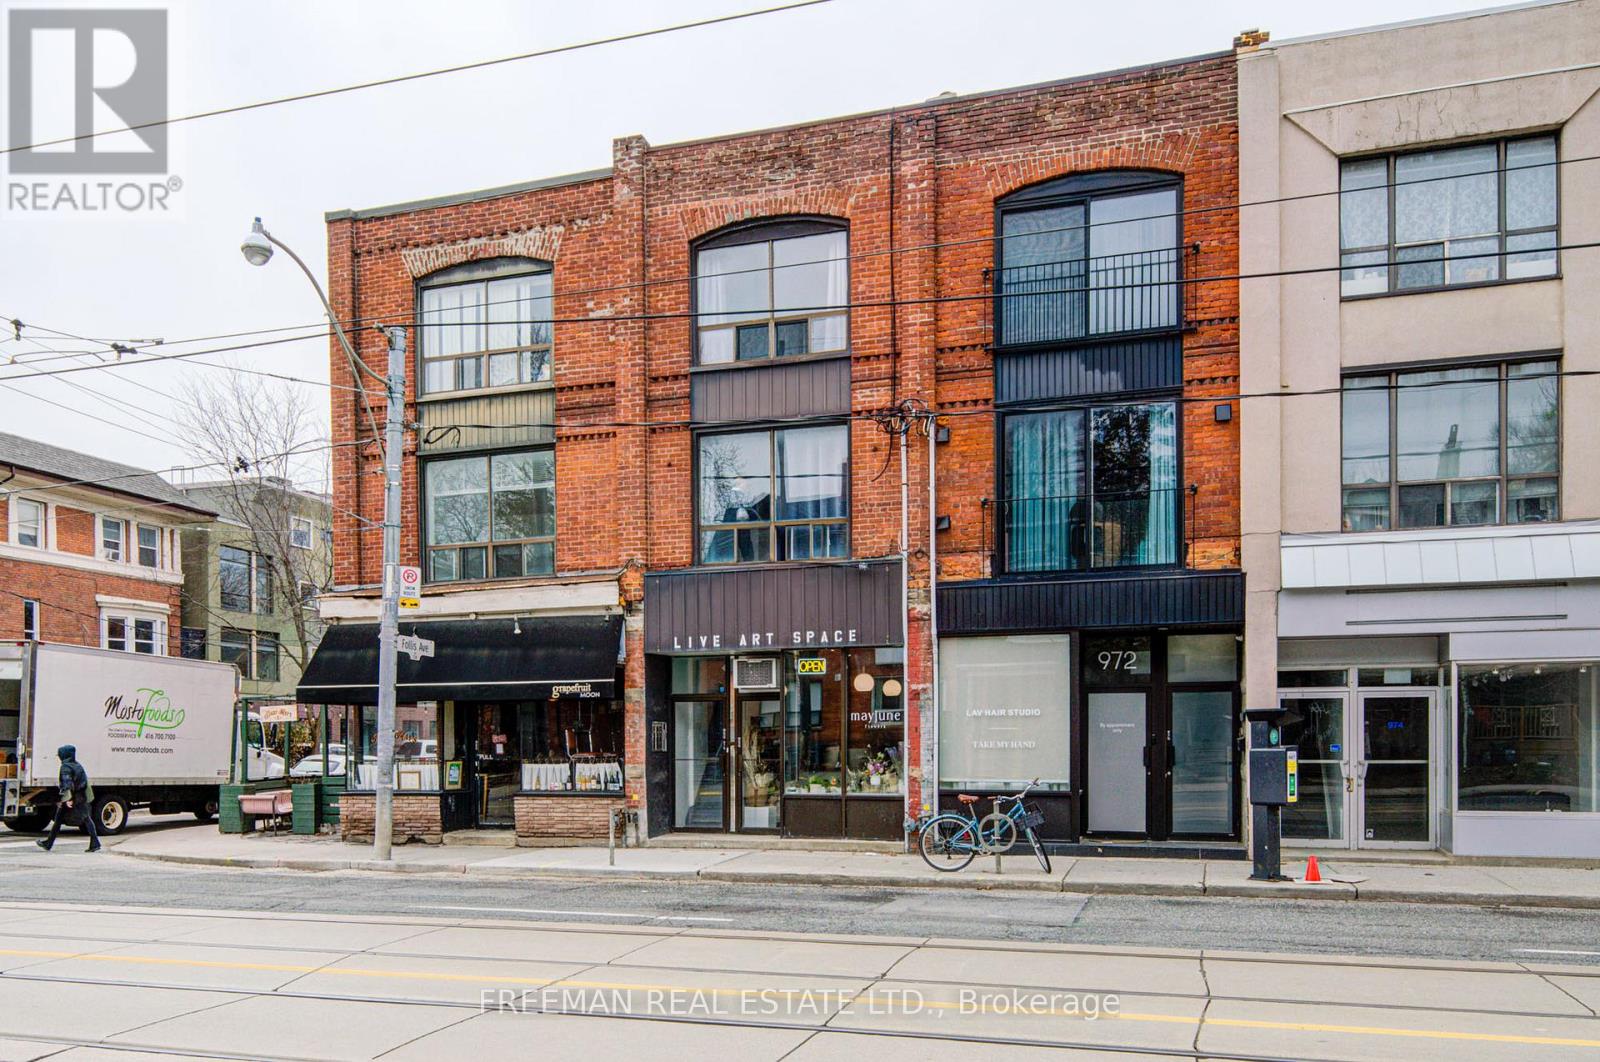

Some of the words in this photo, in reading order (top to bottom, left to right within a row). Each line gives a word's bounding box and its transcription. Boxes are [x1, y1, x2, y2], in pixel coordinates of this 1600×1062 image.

[401, 638, 417, 651] Follis
[419, 641, 430, 653] Ave
[673, 635, 721, 649] LIVE
[739, 632, 774, 647] ART
[792, 629, 857, 643] SPACE
[799, 660, 825, 672] OPEN
[1097, 651, 1137, 670] 972
[552, 683, 591, 698] grapefruit
[966, 708, 983, 717] LAV
[984, 708, 1006, 717] HAIR
[1007, 707, 1041, 716] STUDIO
[974, 740, 993, 749] TAKE
[996, 740, 1008, 749] MY
[1010, 740, 1036, 749] HAND
